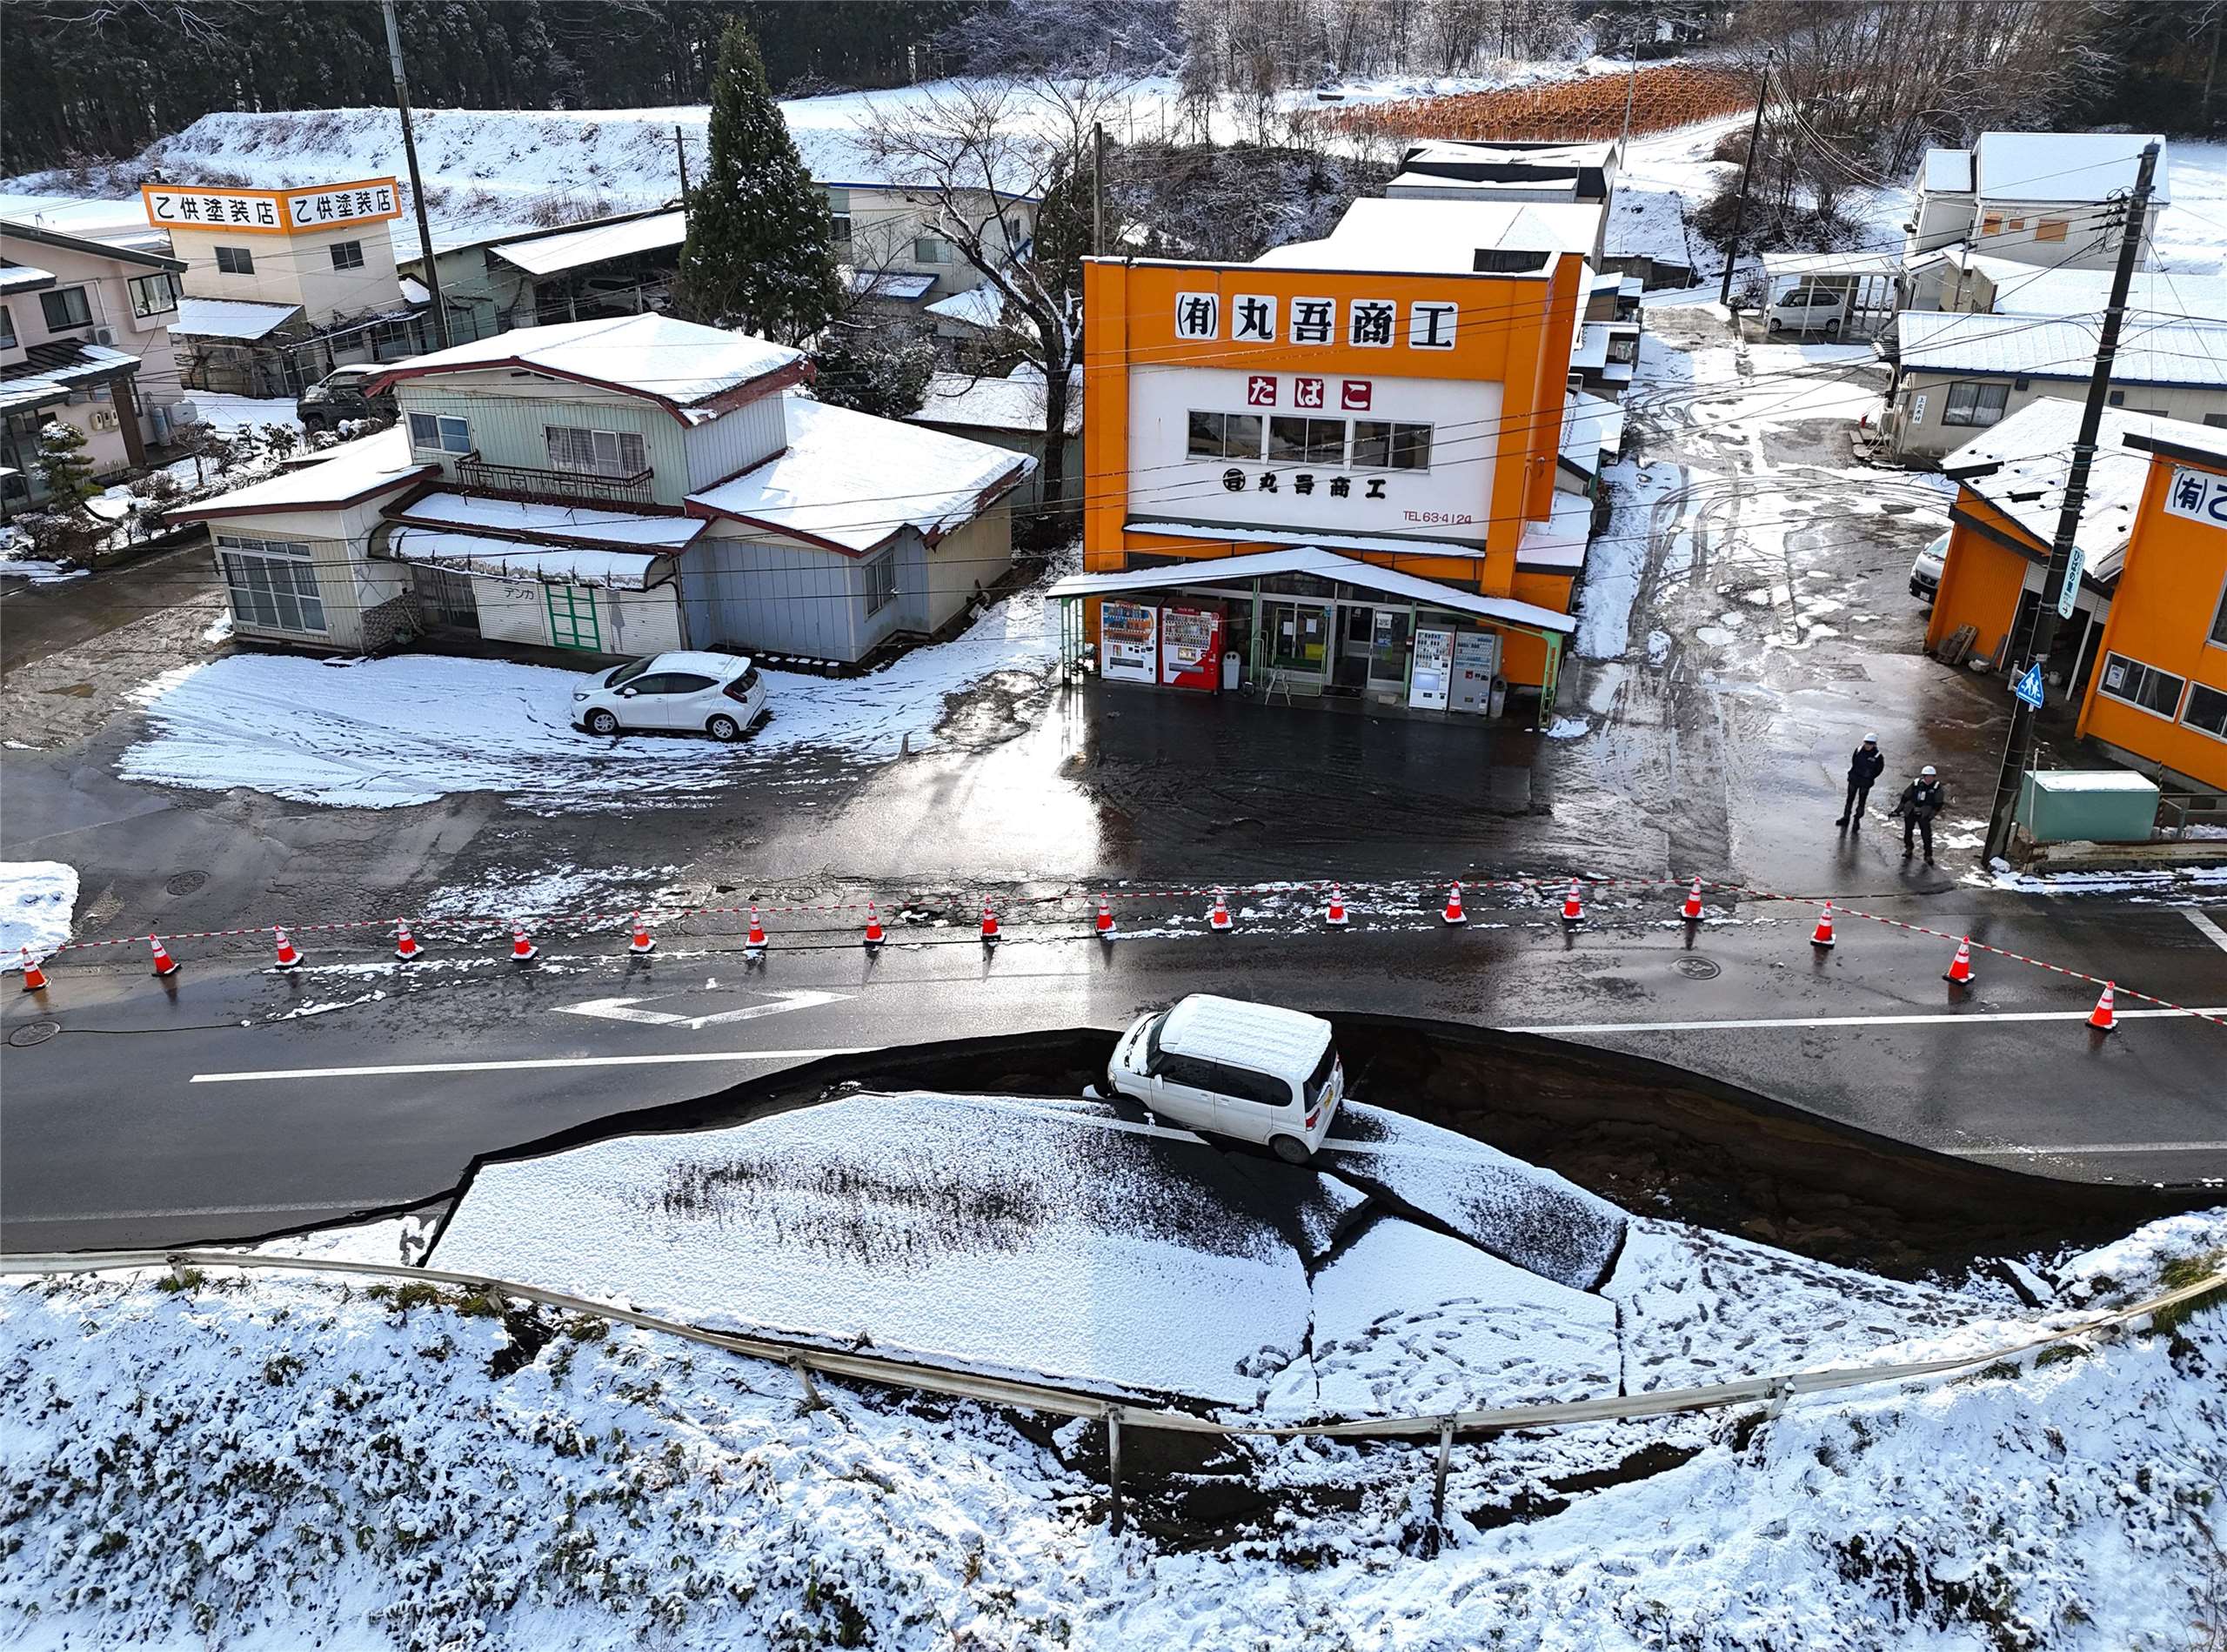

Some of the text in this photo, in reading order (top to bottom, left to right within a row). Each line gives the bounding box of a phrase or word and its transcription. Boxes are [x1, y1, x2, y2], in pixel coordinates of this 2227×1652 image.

[156, 196, 275, 224] 乙供塗装店
[294, 188, 392, 224] 乙供塗装店
[1248, 378, 1369, 409] たばこ
